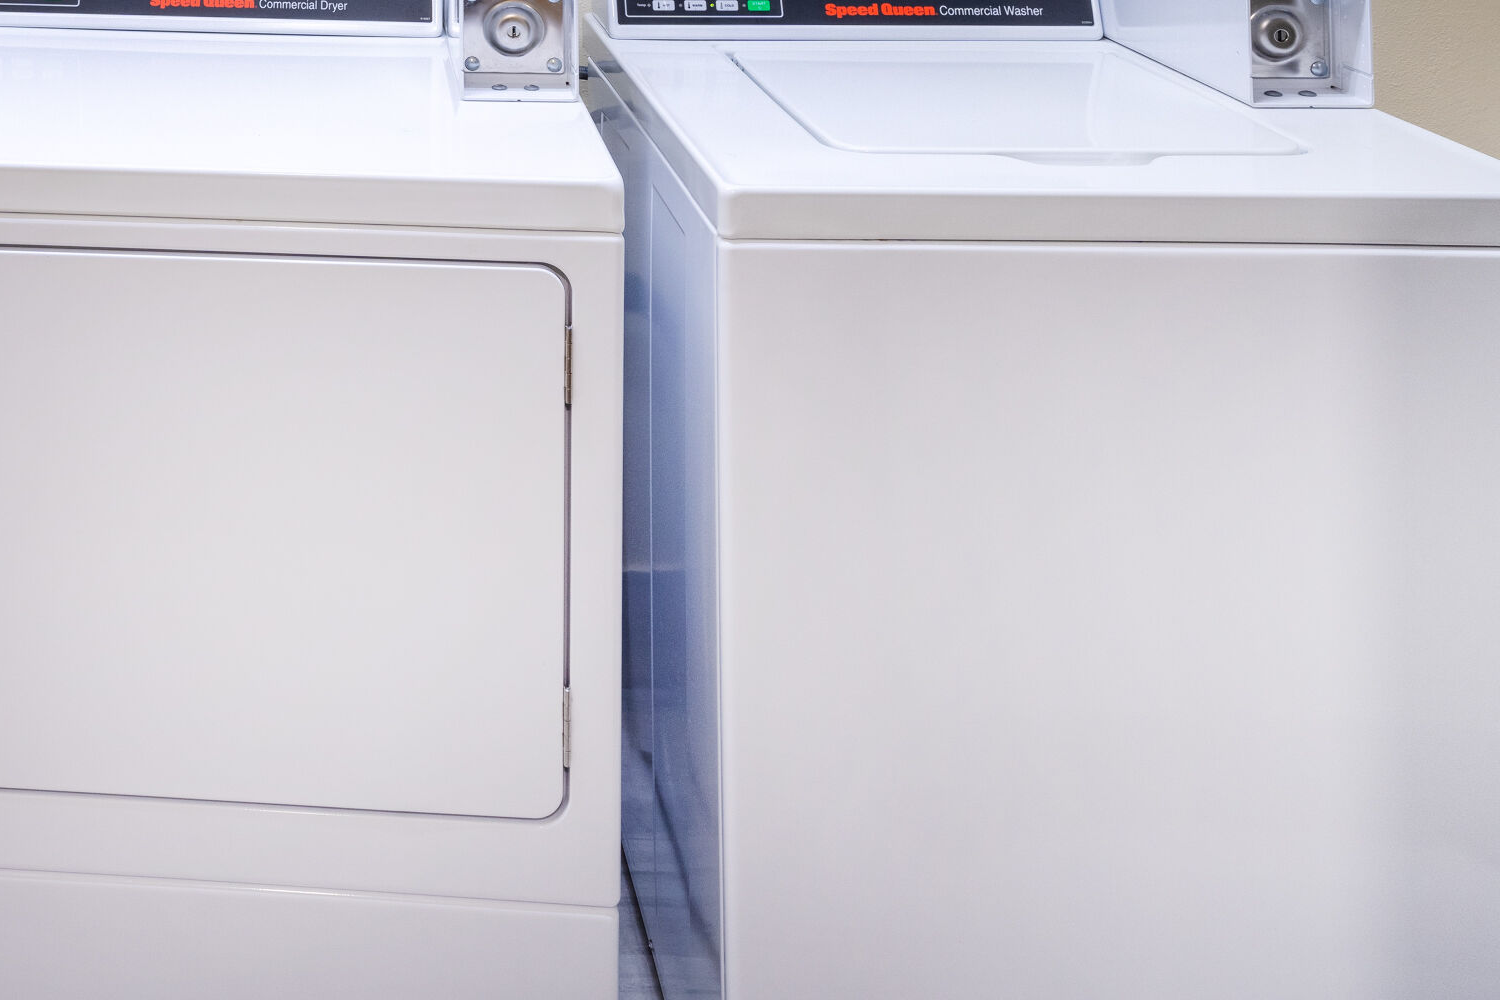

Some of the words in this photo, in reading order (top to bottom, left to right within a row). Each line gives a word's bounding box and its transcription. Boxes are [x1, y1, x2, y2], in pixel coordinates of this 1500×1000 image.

[319, 0, 348, 13] Dryer
[825, 3, 880, 18] Speed
[881, 4, 936, 18] Queen
[939, 4, 1002, 17] Commercial
[1003, 5, 1043, 17] Washer
